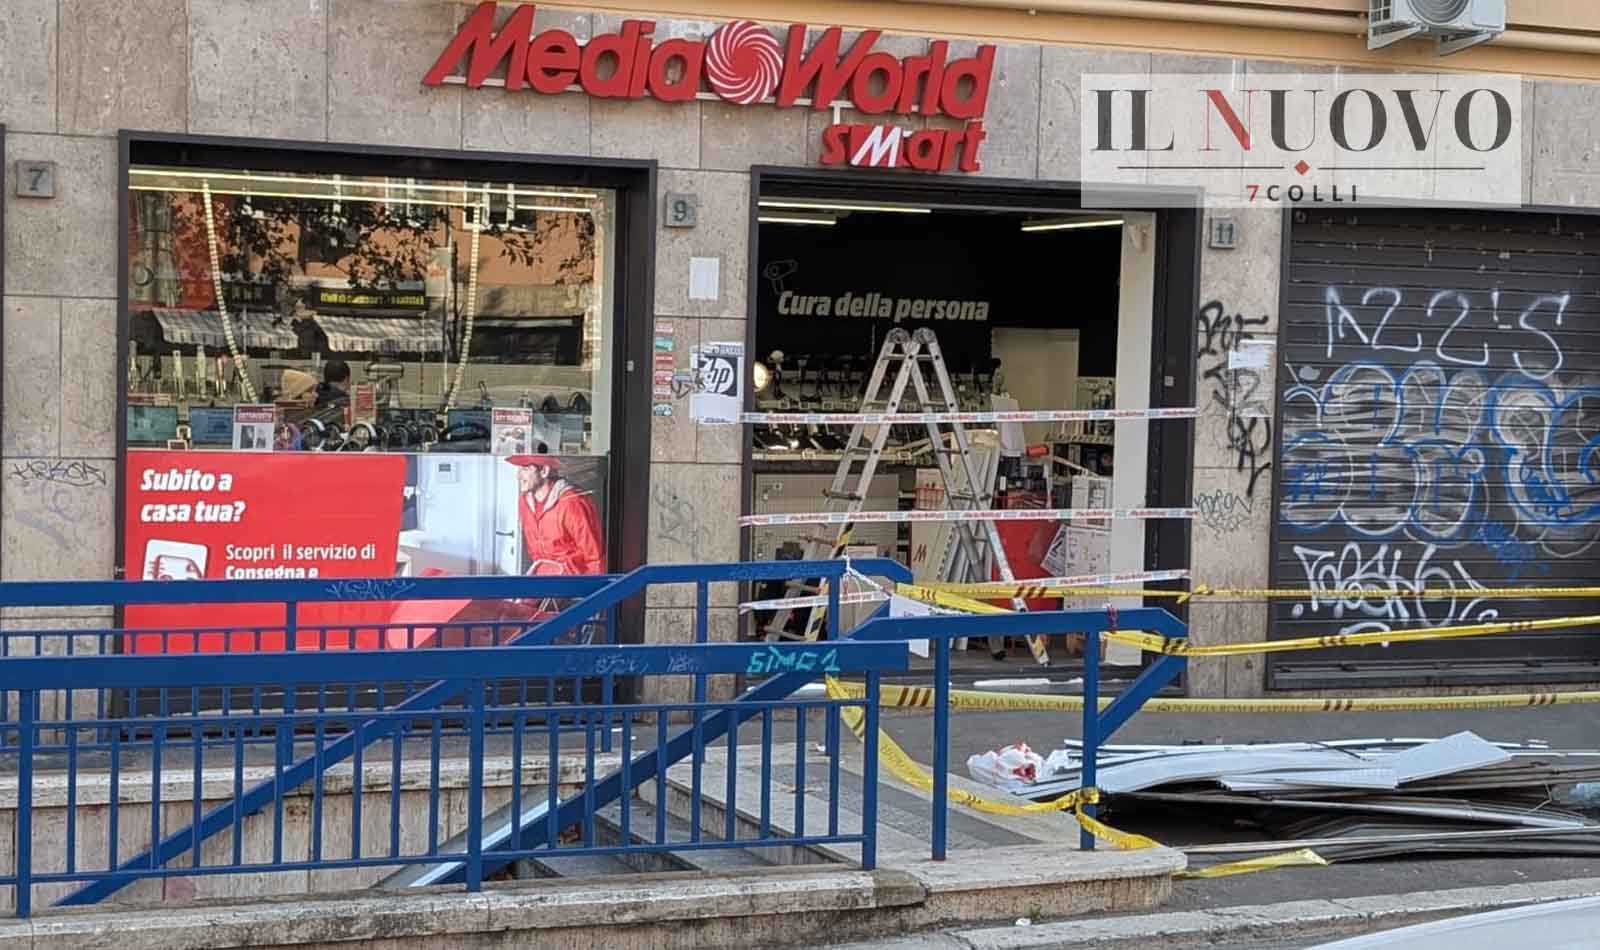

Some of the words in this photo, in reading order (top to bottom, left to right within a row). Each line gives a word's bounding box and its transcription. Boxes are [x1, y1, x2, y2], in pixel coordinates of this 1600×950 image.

[29, 168, 47, 191] 7
[674, 200, 687, 222] 9
[1215, 223, 1233, 245] 11
[778, 290, 832, 316] Cura
[834, 291, 892, 318] della
[893, 297, 990, 323] persona
[140, 468, 215, 492] Subito
[217, 473, 233, 491] a
[140, 502, 191, 523] casa
[194, 500, 246, 523] tua?
[225, 544, 275, 563] Scopri
[282, 544, 293, 560] il
[296, 544, 357, 560] servizio
[360, 544, 376, 560] di
[225, 565, 306, 579] Consegna
